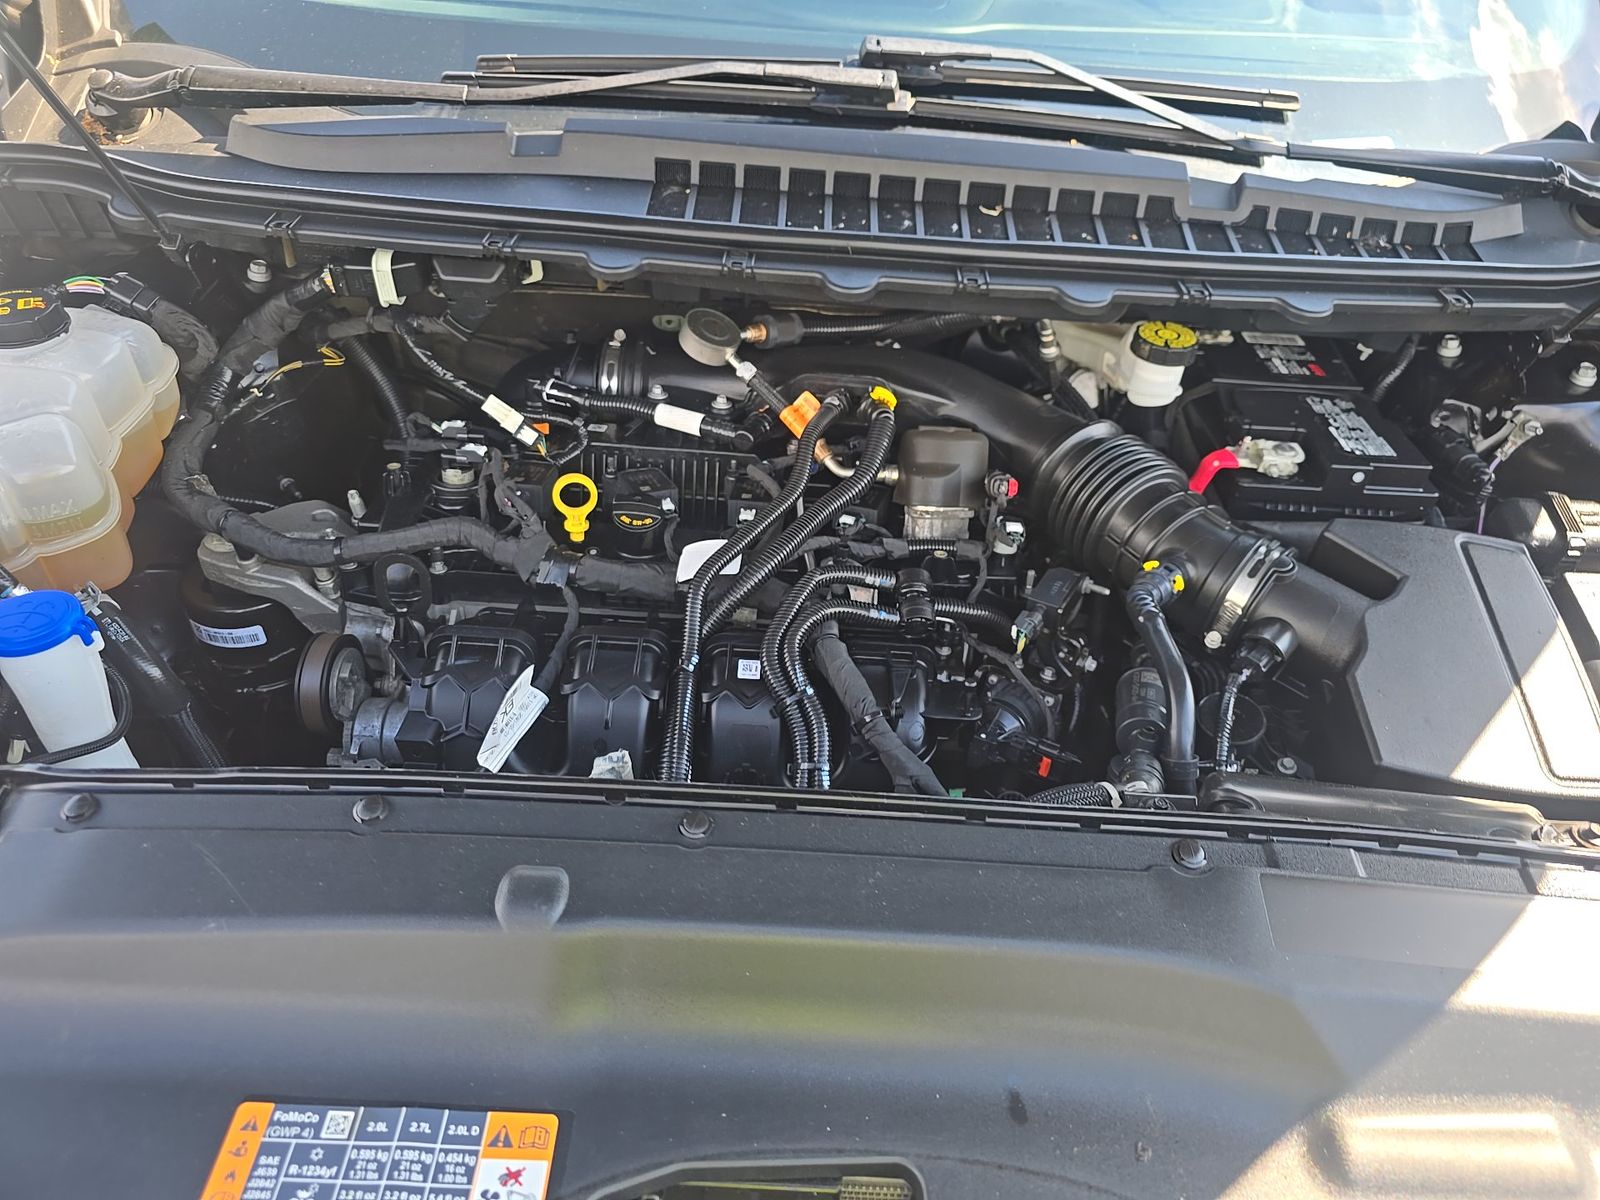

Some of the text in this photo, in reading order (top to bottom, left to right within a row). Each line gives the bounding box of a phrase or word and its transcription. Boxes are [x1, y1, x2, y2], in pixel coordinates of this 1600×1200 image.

[273, 1110, 320, 1123] FoMoCo
[265, 1126, 315, 1140] (GWP 4)
[366, 1121, 389, 1133] 2.0L
[409, 1122, 432, 1134] 2.7L
[448, 1125, 480, 1136] 2.0L D
[258, 1155, 281, 1165] SAE
[376, 1150, 389, 1163] kg
[420, 1150, 433, 1165] kg
[438, 1151, 477, 1167] 0.454 kg
[288, 1164, 339, 1178] R-1234yf
[355, 1160, 378, 1170] 21 oz
[399, 1160, 422, 1171] 21 oz
[455, 1165, 466, 1174] oz
[350, 1169, 379, 1180] 1.31 lbs
[393, 1170, 424, 1182] 1.31 lbs
[438, 1173, 468, 1184] 1.00 lbs
